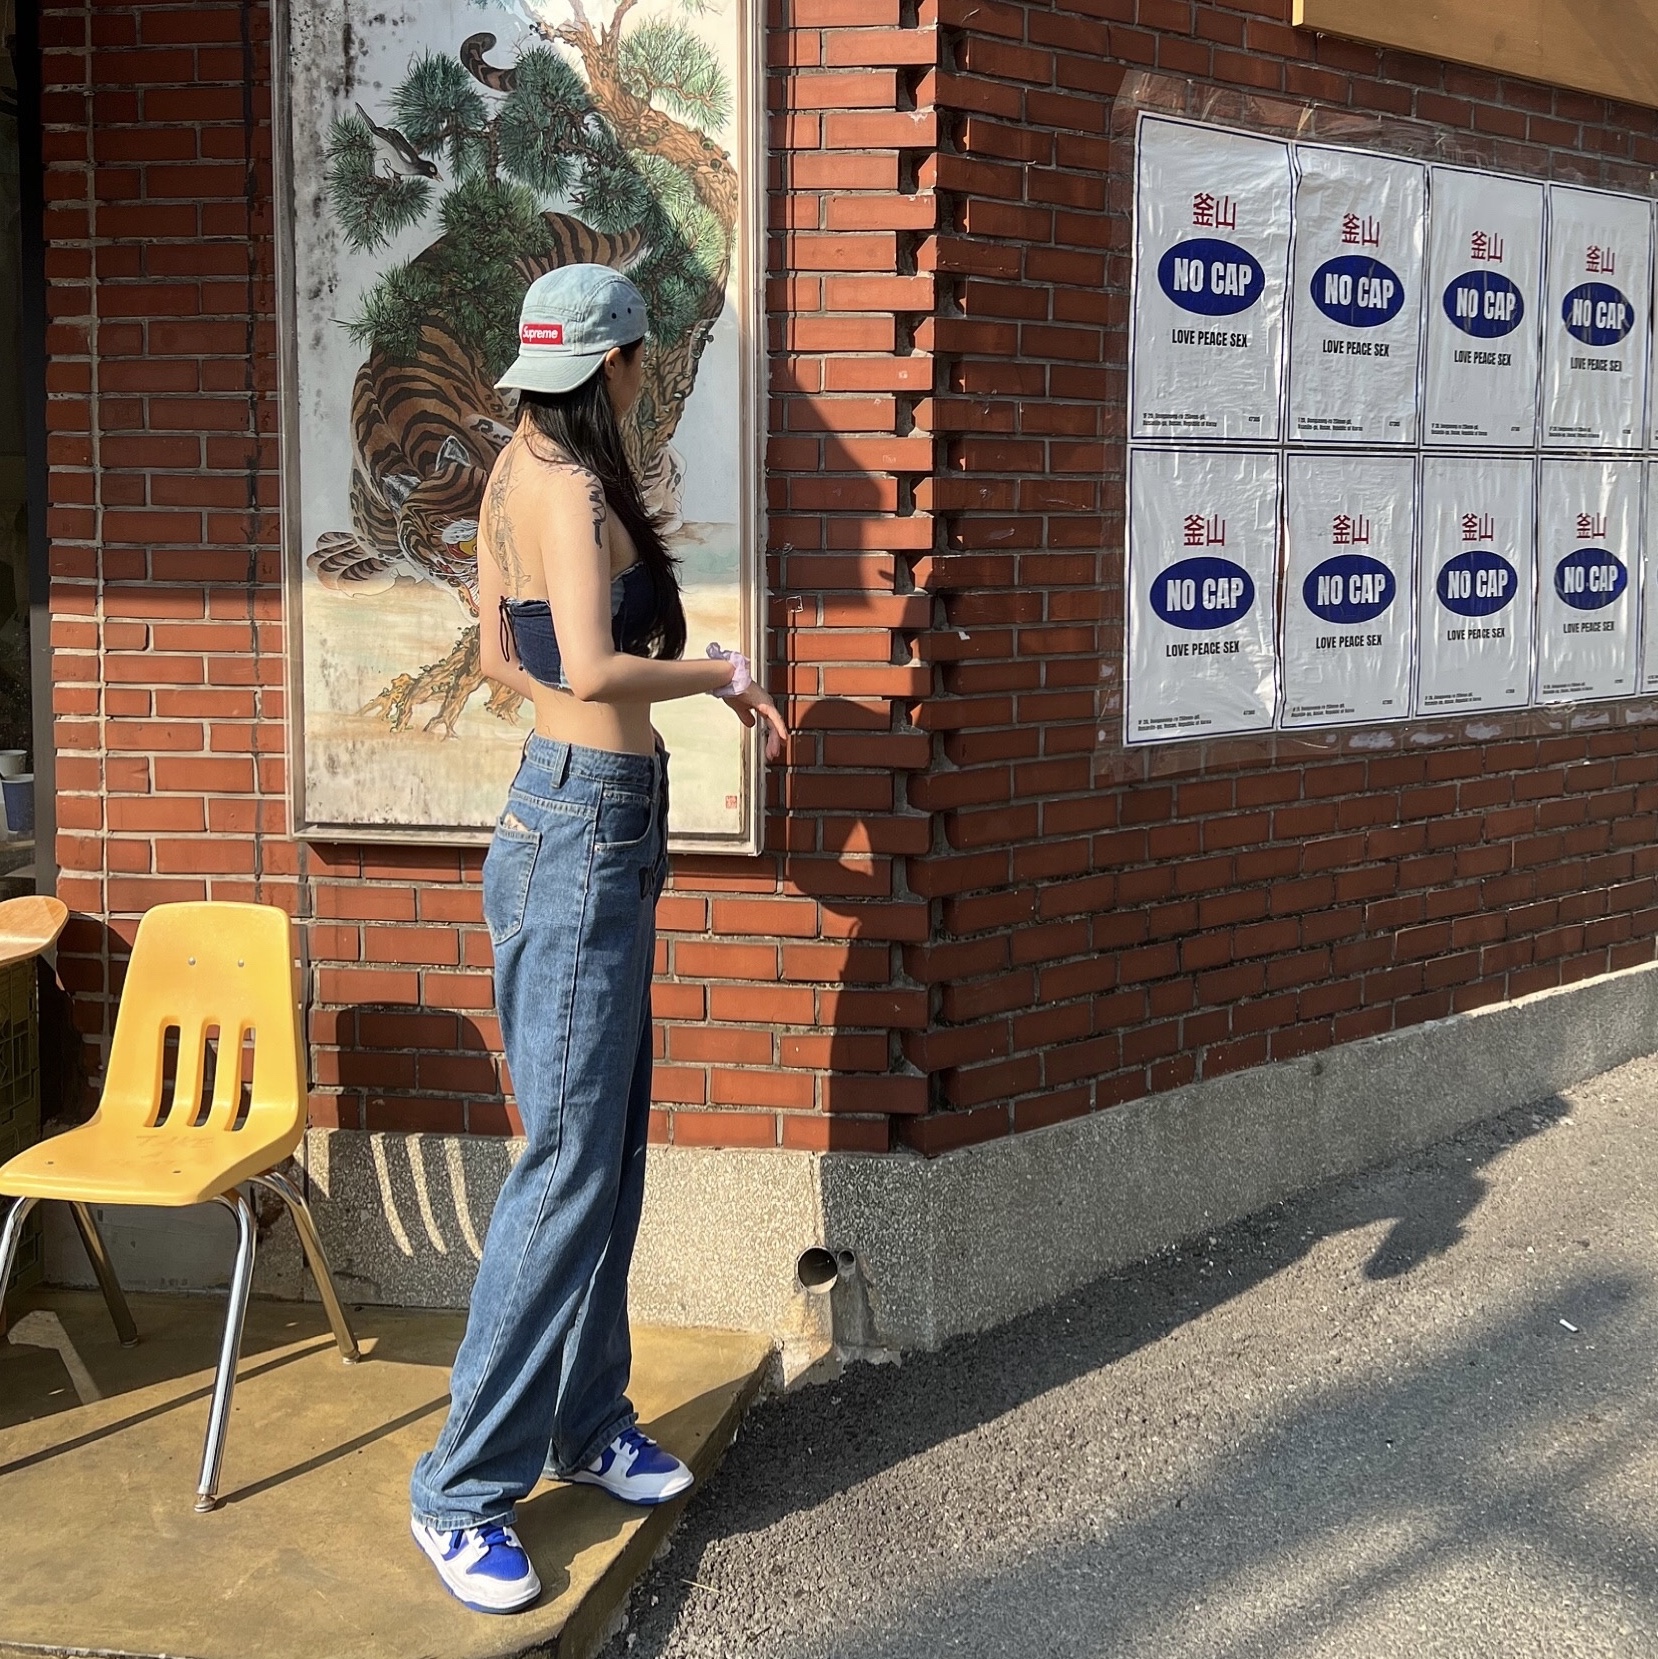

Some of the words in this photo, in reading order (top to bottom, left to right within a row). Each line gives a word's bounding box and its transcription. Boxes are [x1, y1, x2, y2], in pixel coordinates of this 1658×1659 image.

[1193, 193, 1237, 230] 釜山
[1343, 214, 1380, 246] 釜山
[1471, 231, 1504, 262] 釜山
[1586, 245, 1615, 275] 釜山
[1174, 258, 1203, 292] NO
[1211, 262, 1252, 296] CAP
[1325, 273, 1352, 305] NO
[1358, 277, 1394, 309] CAP
[1456, 288, 1478, 317] NO
[1484, 291, 1515, 320] CAP
[1572, 299, 1591, 327] NO
[1596, 302, 1625, 329] CAP
[523, 326, 558, 342] Supreme
[1172, 329, 1195, 344] LOVE
[1198, 331, 1227, 346] PEACE
[1230, 333, 1247, 347] SEX
[1323, 340, 1344, 353] LOVE
[1347, 342, 1371, 355] PEACE
[1374, 344, 1389, 356] SEX
[1455, 351, 1471, 363] LOVE
[1474, 352, 1495, 365] PEACE
[1498, 354, 1511, 366] SEX
[1571, 358, 1585, 369] LOVE
[1588, 359, 1607, 371] PEACE
[1184, 514, 1226, 547] 釜山
[1333, 515, 1371, 545] 釜山
[1462, 512, 1494, 542] 釜山
[1577, 512, 1607, 540] 釜山
[1318, 575, 1343, 605] NO
[1349, 574, 1385, 604] CAP
[1448, 571, 1471, 598] NO
[1476, 569, 1508, 597] CAP
[1564, 567, 1584, 593] NO
[1590, 565, 1618, 592] CAP
[1167, 579, 1195, 611] NO
[1203, 578, 1243, 609] CAP
[1316, 637, 1336, 649] LOVE
[1339, 636, 1364, 647] PEACE
[1367, 635, 1381, 646] SEX
[1448, 630, 1465, 640] LOVE
[1468, 629, 1489, 639] PEACE
[1492, 628, 1504, 638] SEX
[1564, 623, 1579, 633] LOVE
[1582, 622, 1601, 632] PEACE
[1167, 644, 1188, 657] LOVE
[1192, 642, 1220, 655] PEACE
[1223, 641, 1239, 653] SEX
